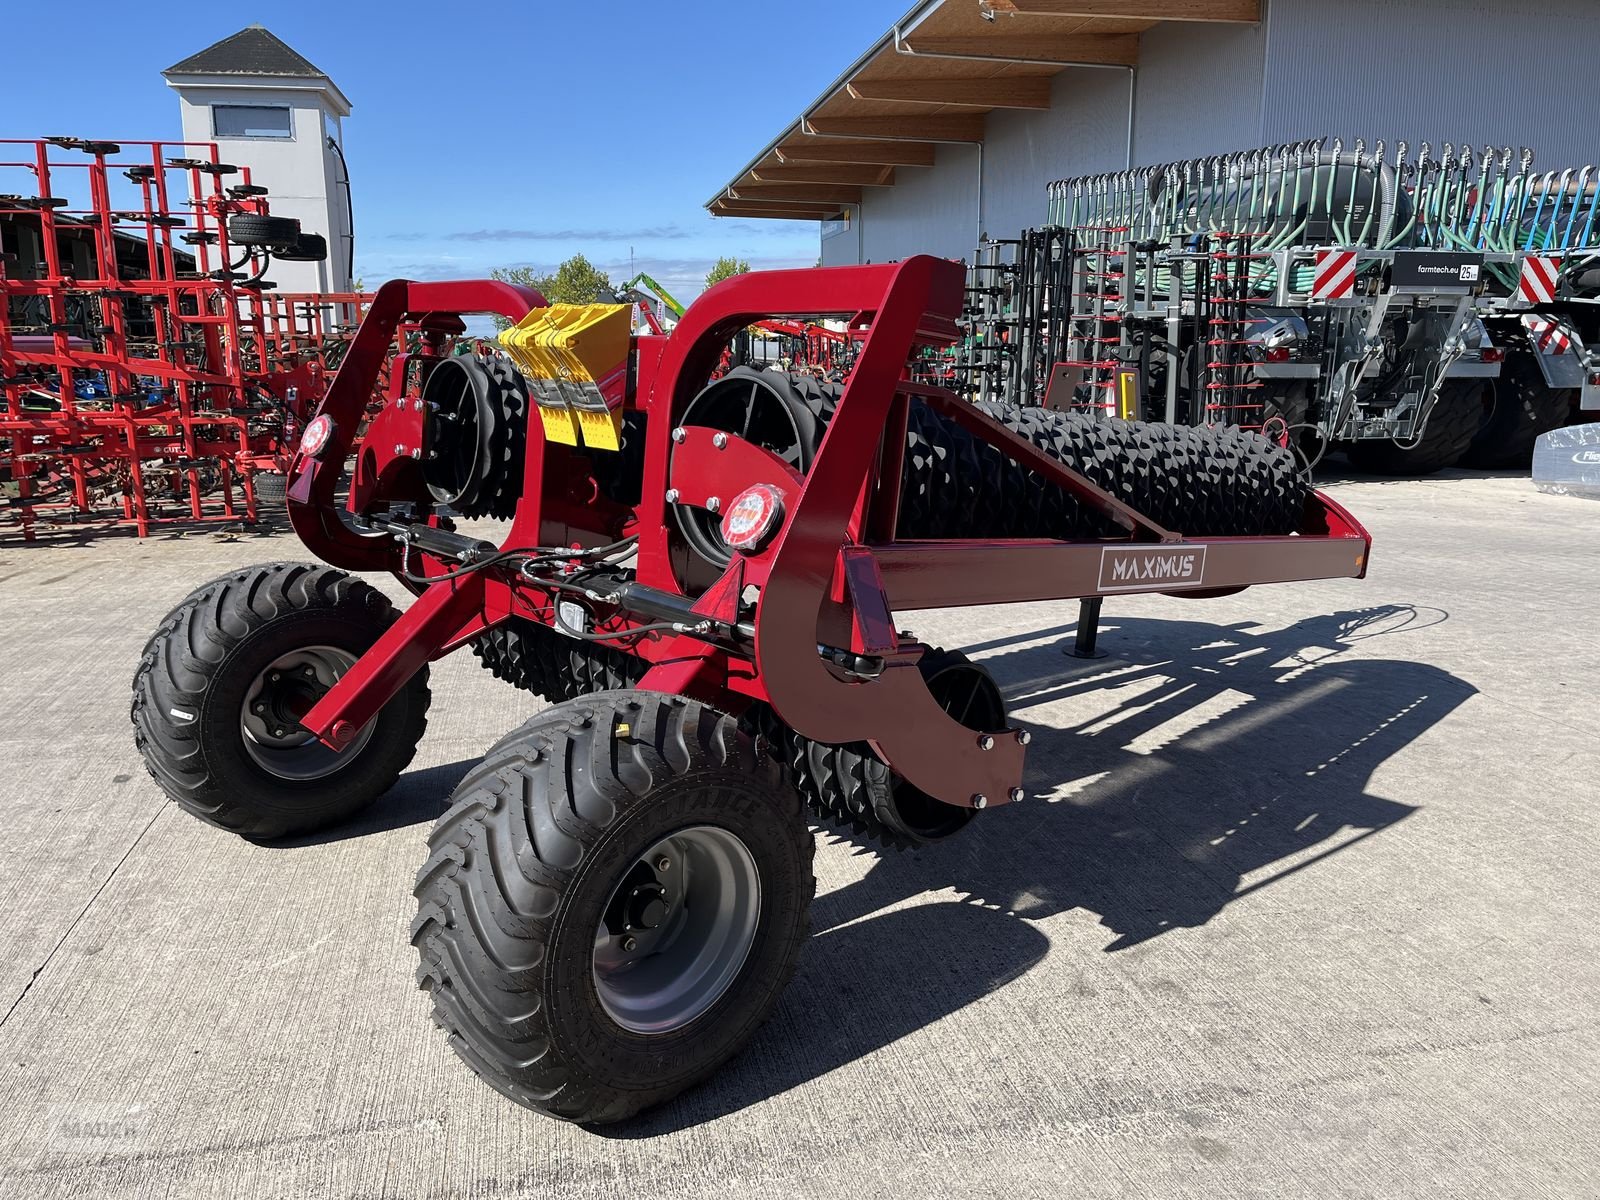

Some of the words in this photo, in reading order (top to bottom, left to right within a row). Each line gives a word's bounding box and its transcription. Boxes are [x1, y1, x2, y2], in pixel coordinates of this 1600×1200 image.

[1418, 264, 1459, 274] farmtech.eu
[1461, 266, 1471, 279] 25
[1112, 555, 1195, 580] MAXIMUS
